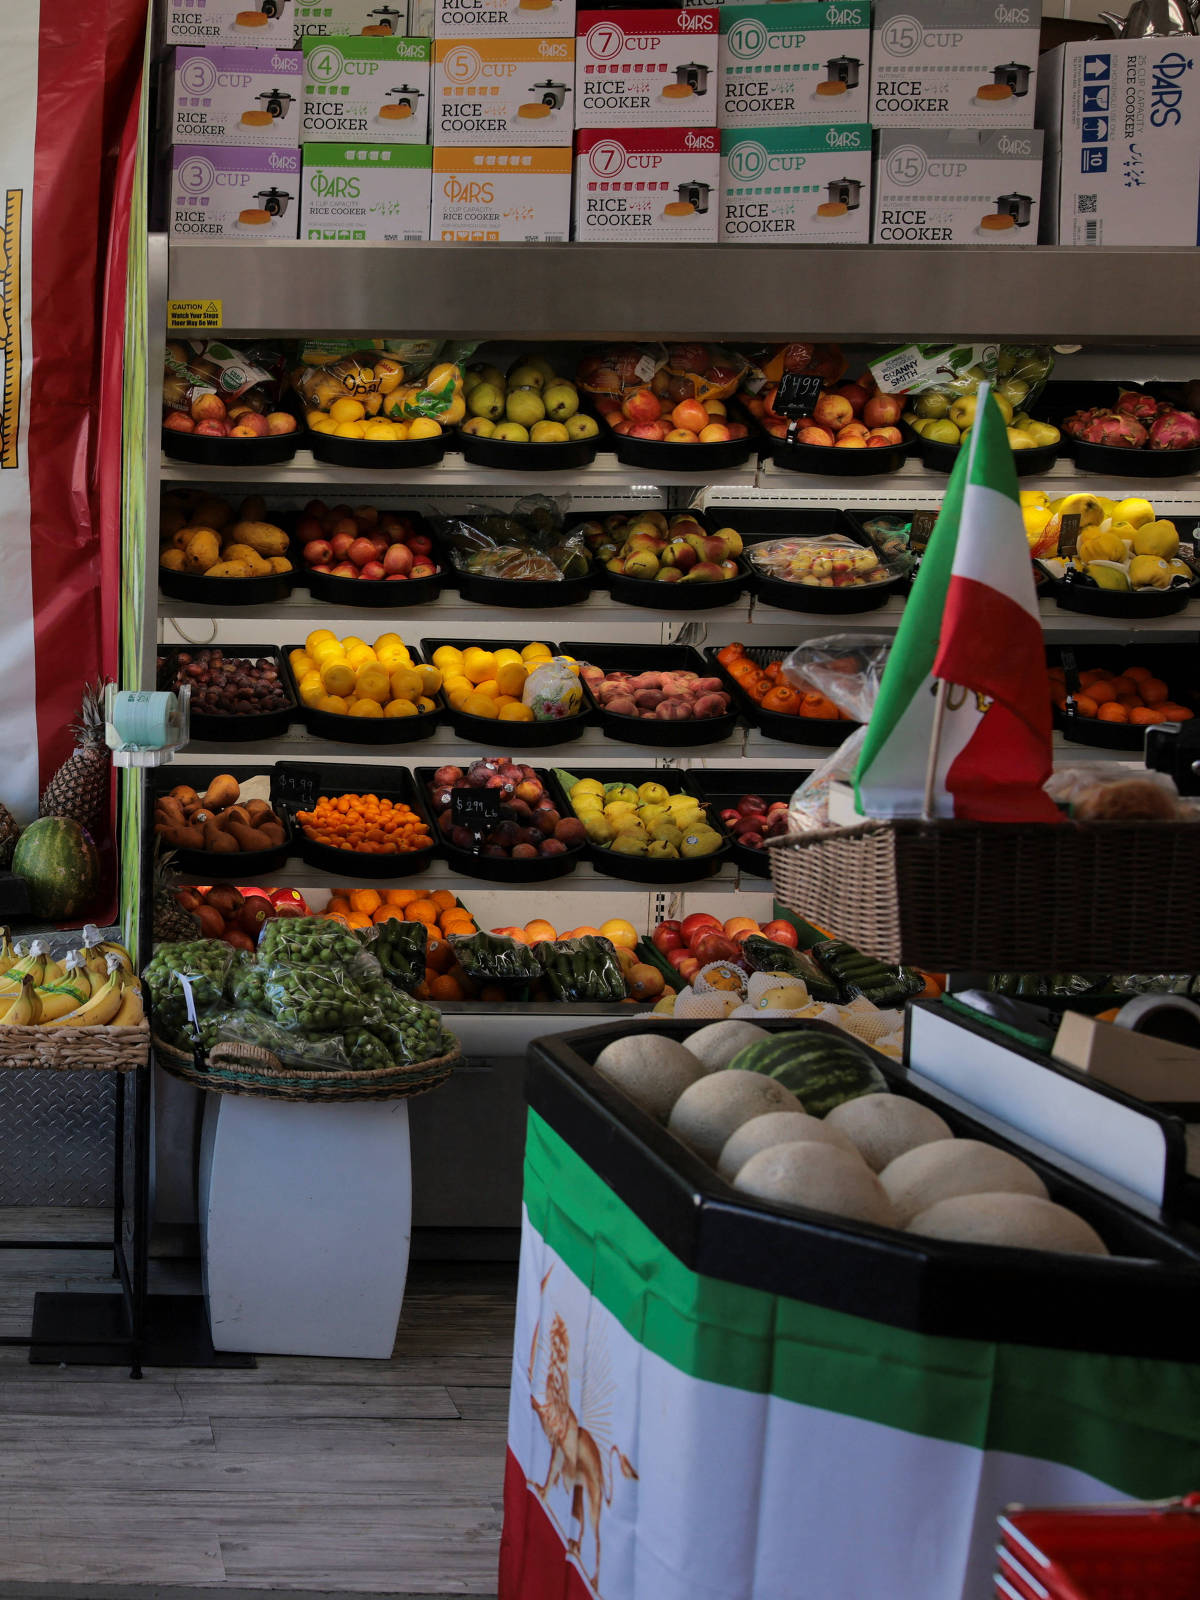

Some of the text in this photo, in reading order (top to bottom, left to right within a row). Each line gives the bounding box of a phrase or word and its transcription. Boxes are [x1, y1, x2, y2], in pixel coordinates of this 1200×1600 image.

[442, 0, 483, 9] RICE
[172, 13, 202, 24] RICE
[441, 11, 509, 24] COOKER
[171, 25, 220, 35] COOKER
[293, 24, 327, 36] RICE
[599, 32, 661, 52] 7 CUP
[735, 30, 806, 50] 10 CUP
[889, 28, 963, 49] 15 CUP
[317, 55, 379, 75] 4 CUP
[455, 56, 517, 77] 5 CUP
[191, 66, 253, 88] 3 CUP
[1138, 68, 1146, 86] CUP
[584, 81, 625, 95] RICE
[725, 82, 769, 97] RICE
[876, 81, 922, 96] RICE
[1150, 52, 1194, 128] PARS
[583, 96, 651, 109] COOKER
[1125, 55, 1137, 139] RICE COOKER
[304, 102, 344, 116] RICE
[441, 104, 482, 117] RICE
[725, 98, 795, 113] COOKER
[875, 98, 949, 112] COOKER
[1136, 89, 1145, 134] CAPACITY
[177, 112, 207, 124] RICE
[303, 118, 368, 131] COOKER
[441, 119, 507, 132] COOKER
[176, 124, 225, 135] COOKER
[600, 150, 663, 170] 7 CUP
[735, 152, 806, 172] 10 CUP
[1090, 152, 1102, 166] 10
[894, 157, 968, 178] 15 CUP
[190, 166, 250, 187] 3 CUP
[310, 169, 360, 198] PARS
[443, 175, 494, 204] PARS
[310, 207, 330, 215] RICE
[331, 207, 367, 215] COOKER
[587, 199, 627, 212] RICE
[725, 204, 769, 219] RICE
[175, 211, 205, 222] RICE
[443, 213, 463, 221] RICE
[464, 213, 500, 221] COOKER
[586, 214, 652, 226] COOKER
[881, 210, 926, 225] RICE
[174, 223, 223, 234] COOKER
[725, 220, 795, 234] COOKER
[880, 227, 953, 241] COOKER
[882, 359, 919, 382] GRANNY
[890, 369, 919, 387] SMITH
[343, 373, 383, 397] Opal
